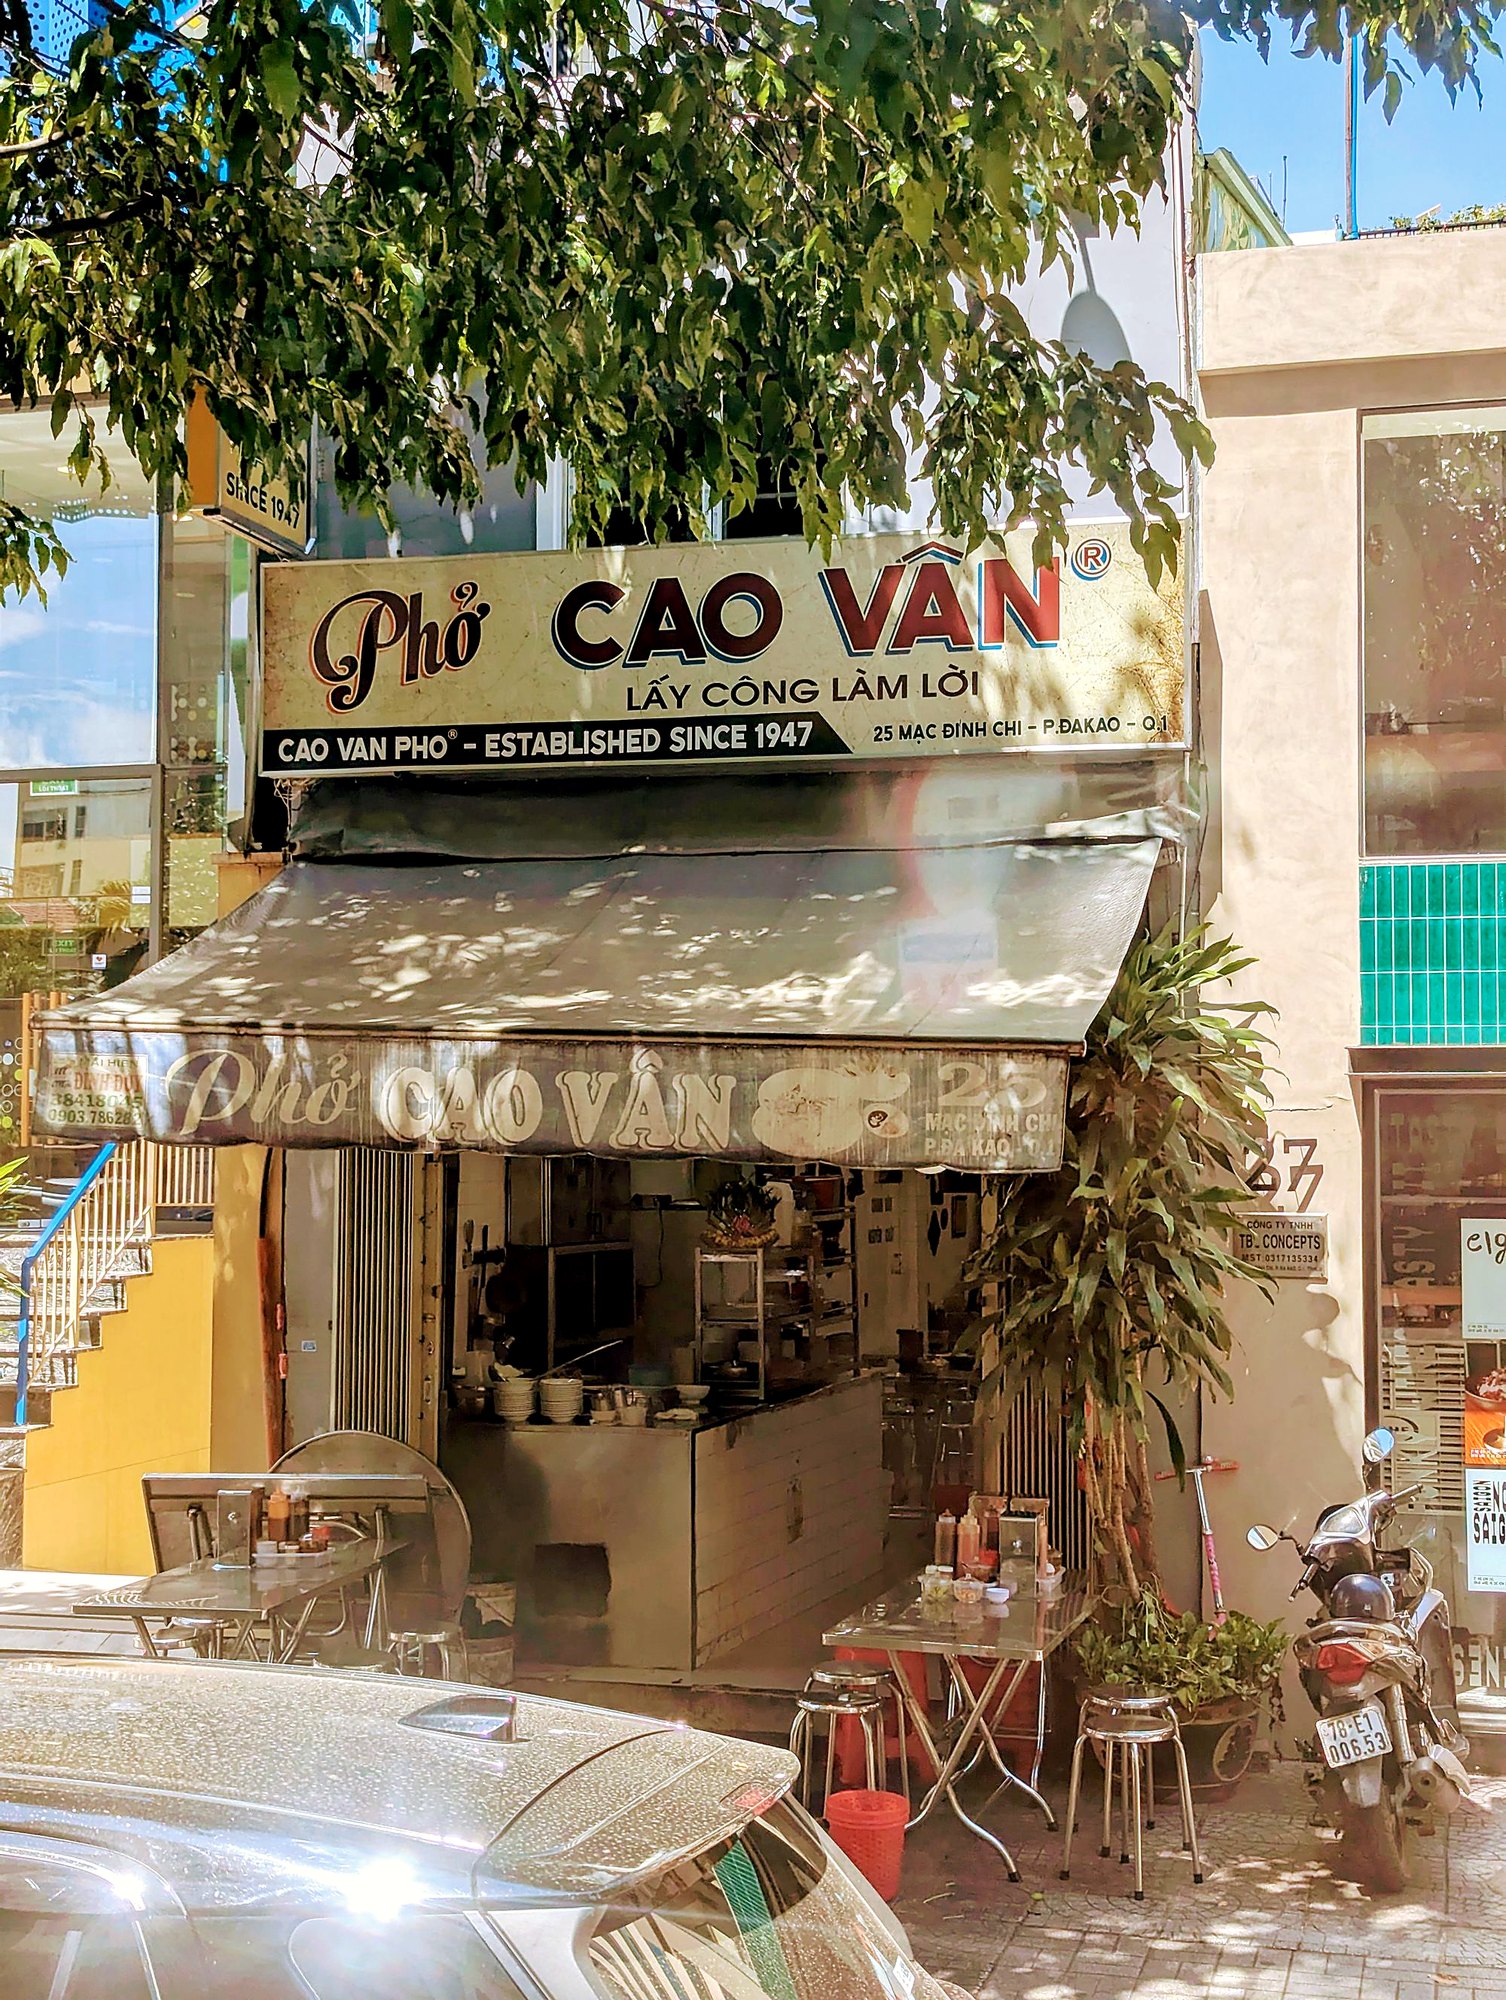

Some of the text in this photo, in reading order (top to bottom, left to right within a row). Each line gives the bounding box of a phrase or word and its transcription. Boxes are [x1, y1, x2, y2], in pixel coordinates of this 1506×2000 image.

[310, 581, 491, 713] Phở
[551, 571, 783, 668] CAO
[818, 541, 1061, 657] VÂN
[627, 664, 979, 711] LẤY CÔNG LÀM LỜI
[278, 738, 329, 762] CAO
[337, 737, 387, 761] VAN
[485, 729, 661, 758] ESTABLISHED
[670, 725, 747, 752] SINCE
[755, 721, 813, 748] 1947
[873, 725, 893, 742] 25
[899, 723, 936, 745] MẠC
[992, 720, 1022, 737] CHI
[1143, 715, 1168, 733] Q.1
[165, 1049, 737, 1150] Phở CAO VÂN
[938, 1061, 1046, 1108] 25
[1263, 1234, 1321, 1250] CONCEPTS
[1276, 1221, 1286, 1229] TY
[1289, 1221, 1313, 1230] TNHH
[1329, 1732, 1387, 1763] 006.53
